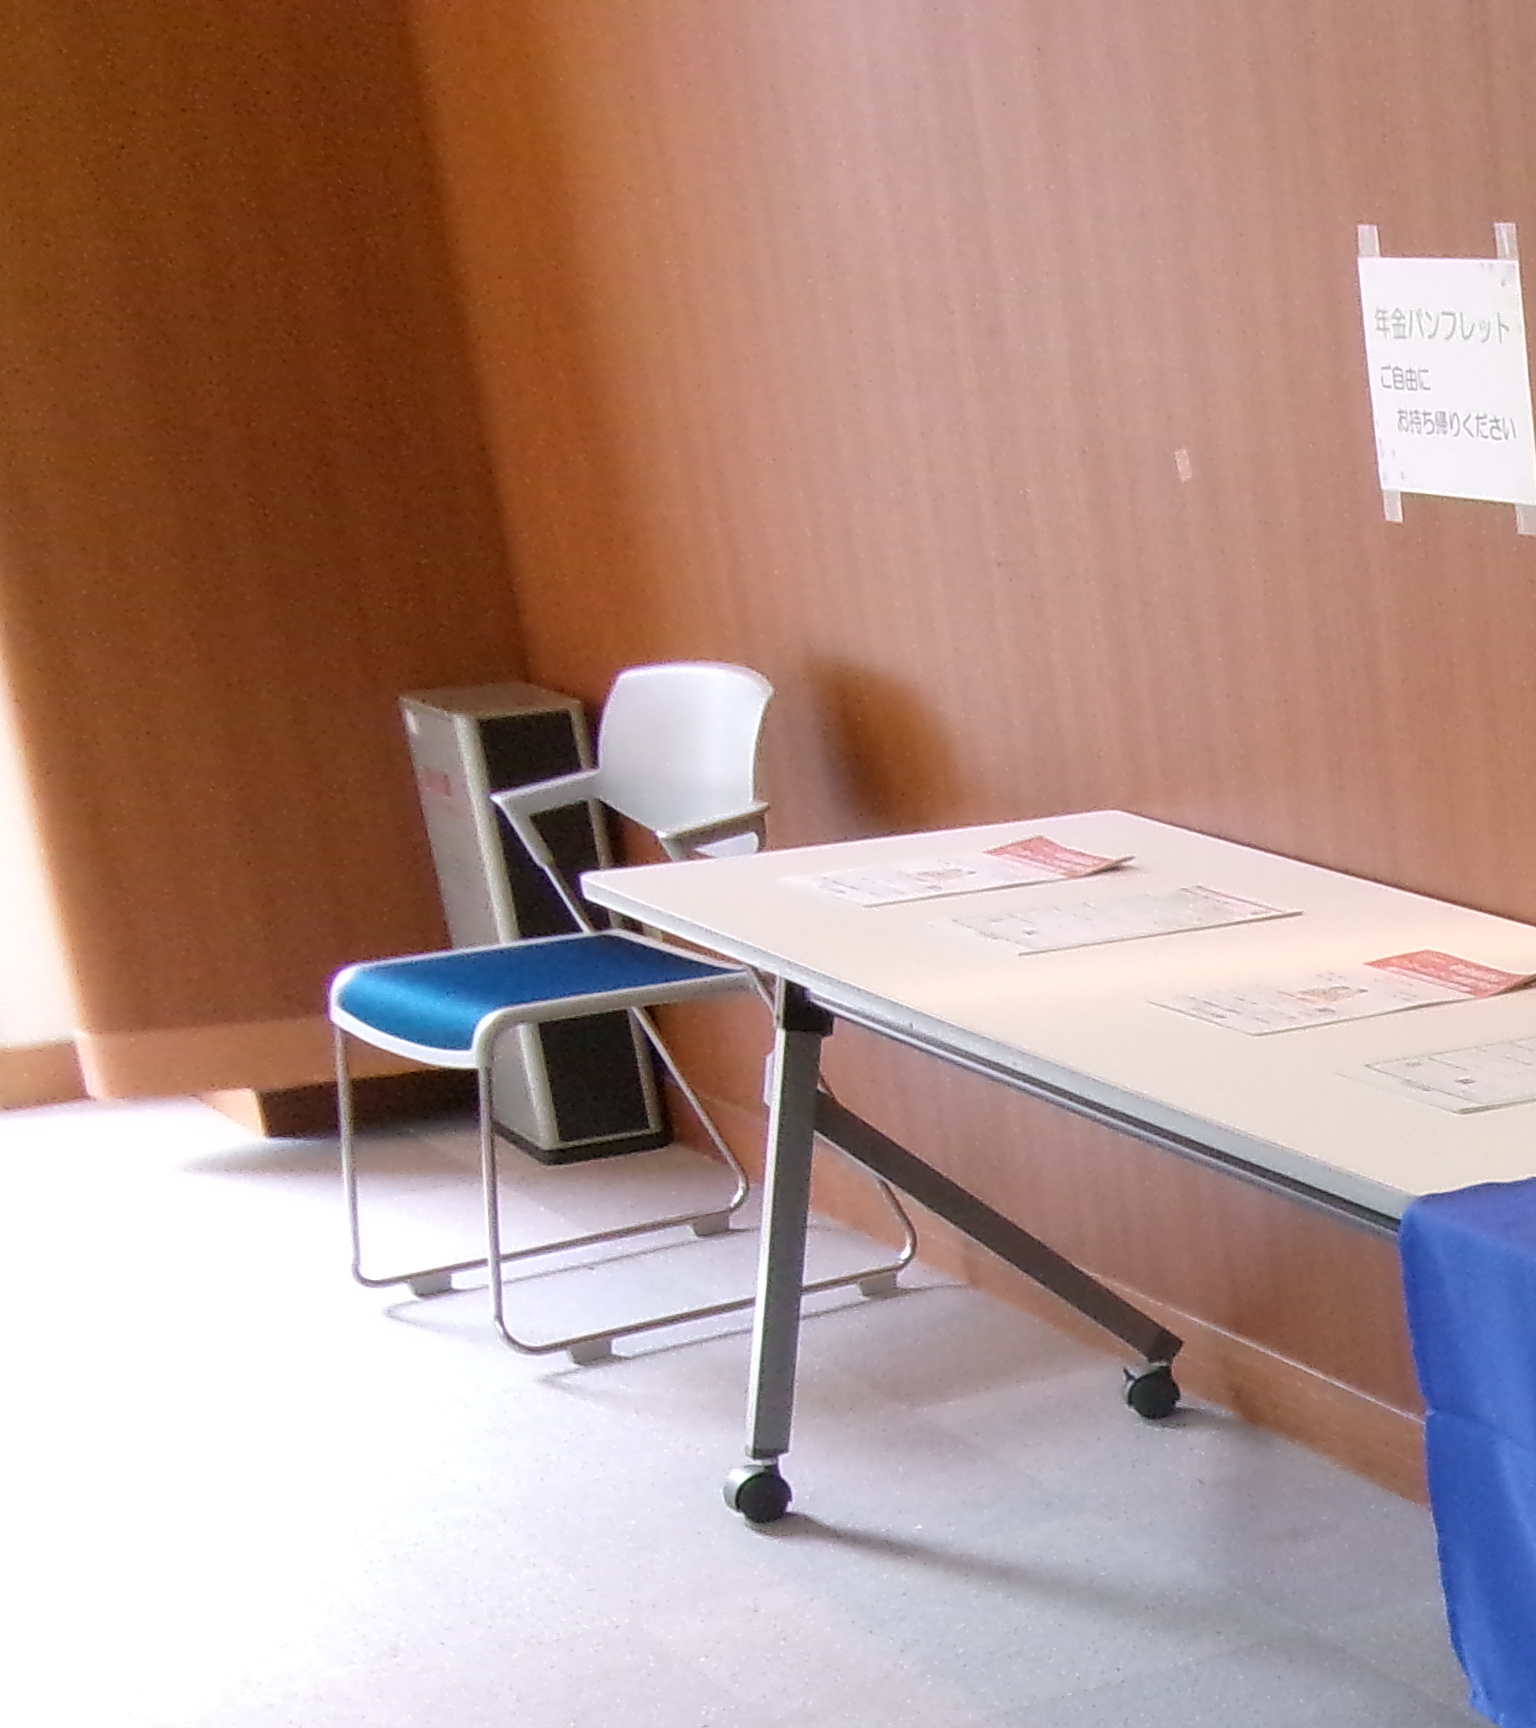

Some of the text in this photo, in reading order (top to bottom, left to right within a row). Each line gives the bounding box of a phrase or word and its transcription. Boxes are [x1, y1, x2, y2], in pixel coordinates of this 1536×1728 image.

[1375, 307, 1510, 344] 年金パンフレット
[1380, 365, 1431, 391] ご自由に
[1397, 408, 1517, 441] お持ち帰りください
